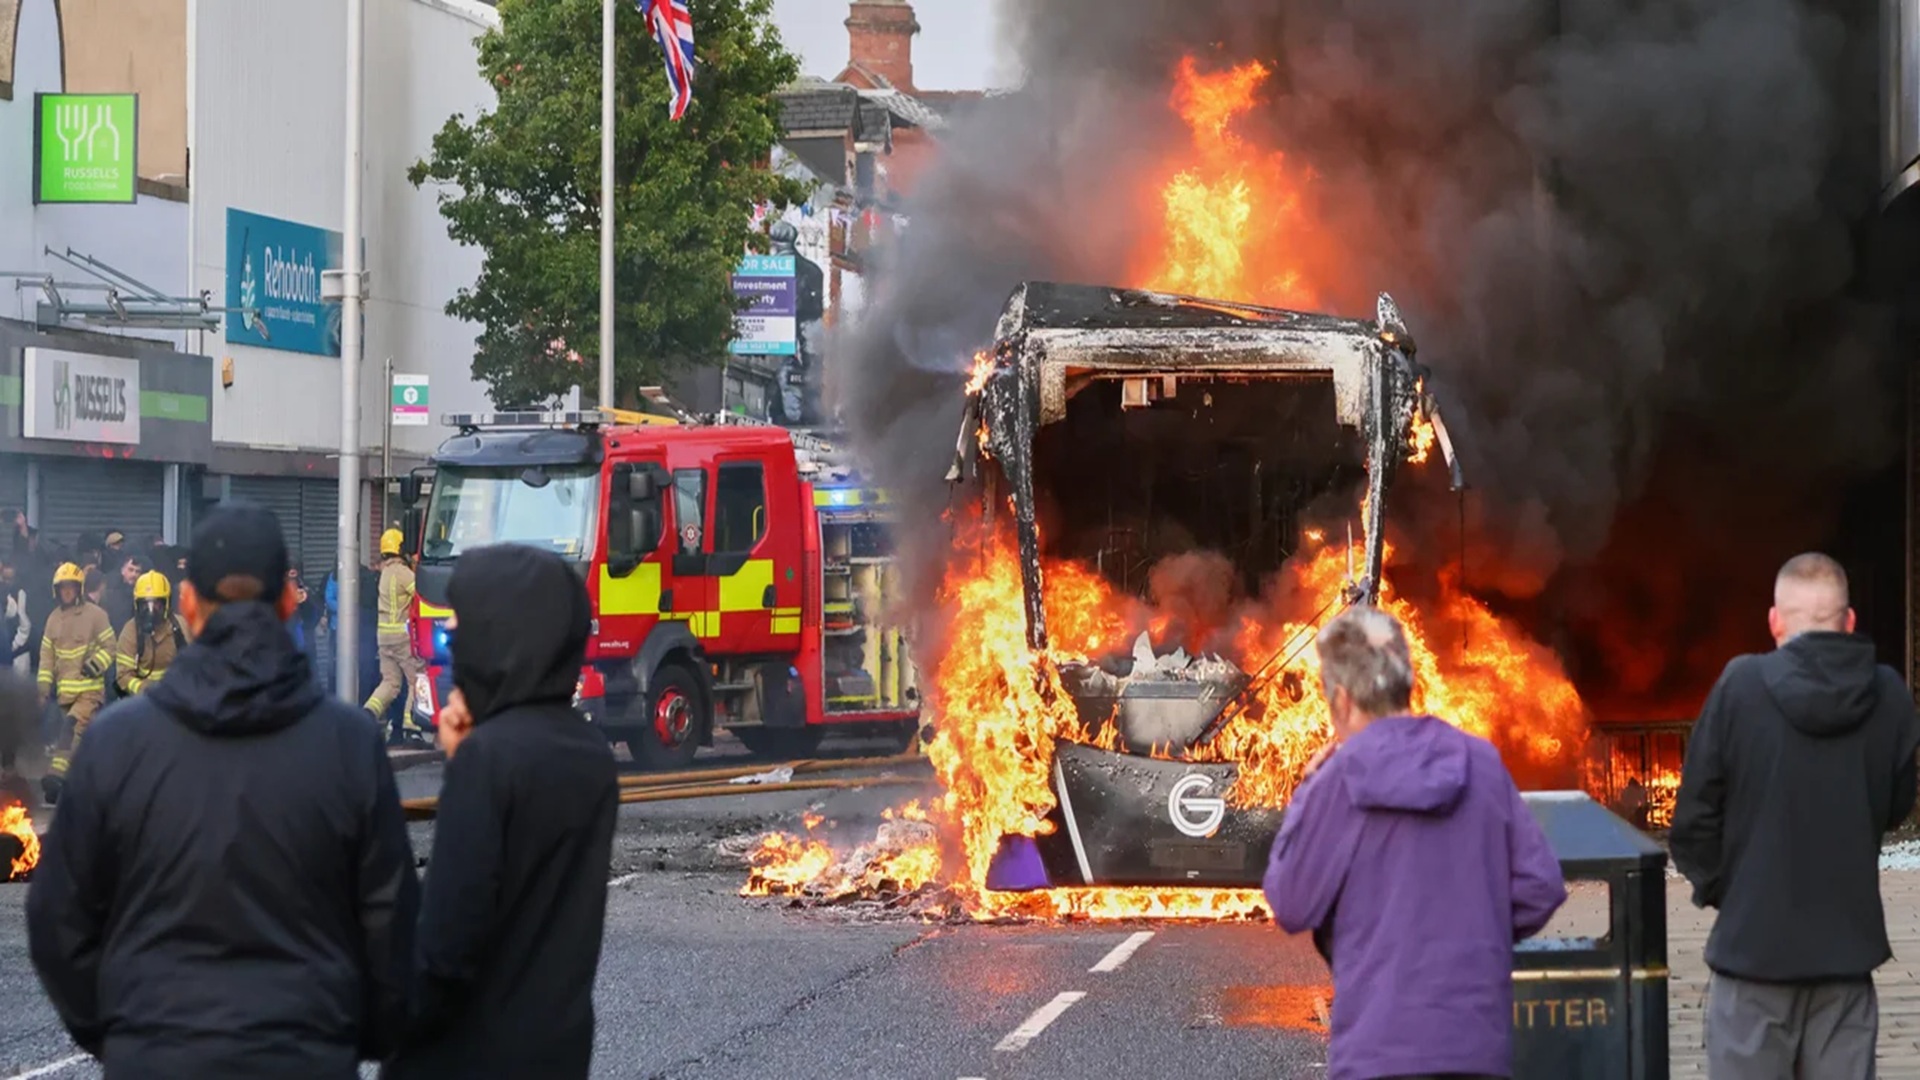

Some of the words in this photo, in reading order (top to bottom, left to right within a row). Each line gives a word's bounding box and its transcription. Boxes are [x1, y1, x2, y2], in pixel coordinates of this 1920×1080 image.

[264, 245, 316, 304] Rehoboth
[743, 258, 759, 270] OR
[762, 258, 793, 270] SALE
[733, 280, 787, 290] Investment
[75, 374, 127, 422] RUSSELL'S
[1513, 999, 1607, 1027] ITTER
